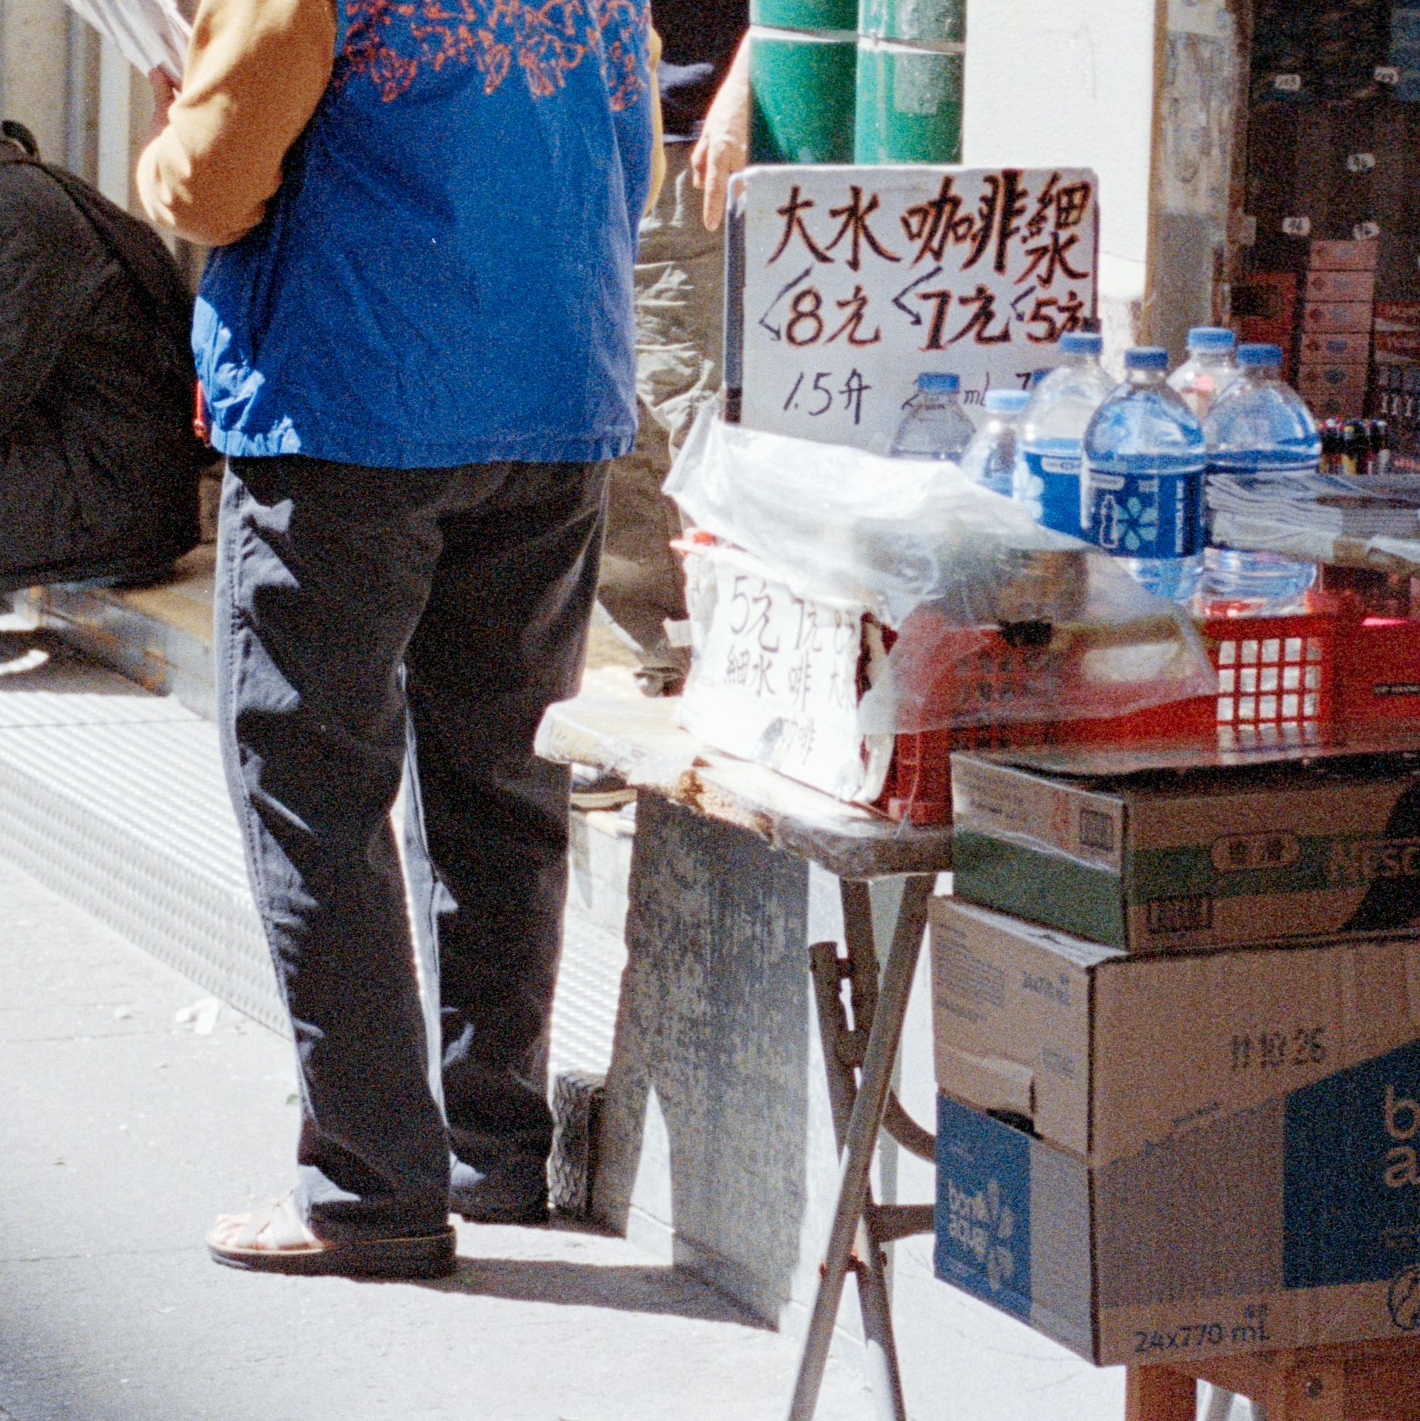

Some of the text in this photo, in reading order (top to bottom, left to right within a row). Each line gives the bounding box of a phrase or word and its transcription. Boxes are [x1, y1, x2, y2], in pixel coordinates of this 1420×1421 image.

[766, 186, 901, 272] 大水
[784, 285, 883, 348] 8元
[915, 284, 1012, 352] 7元
[729, 574, 779, 654] 5元
